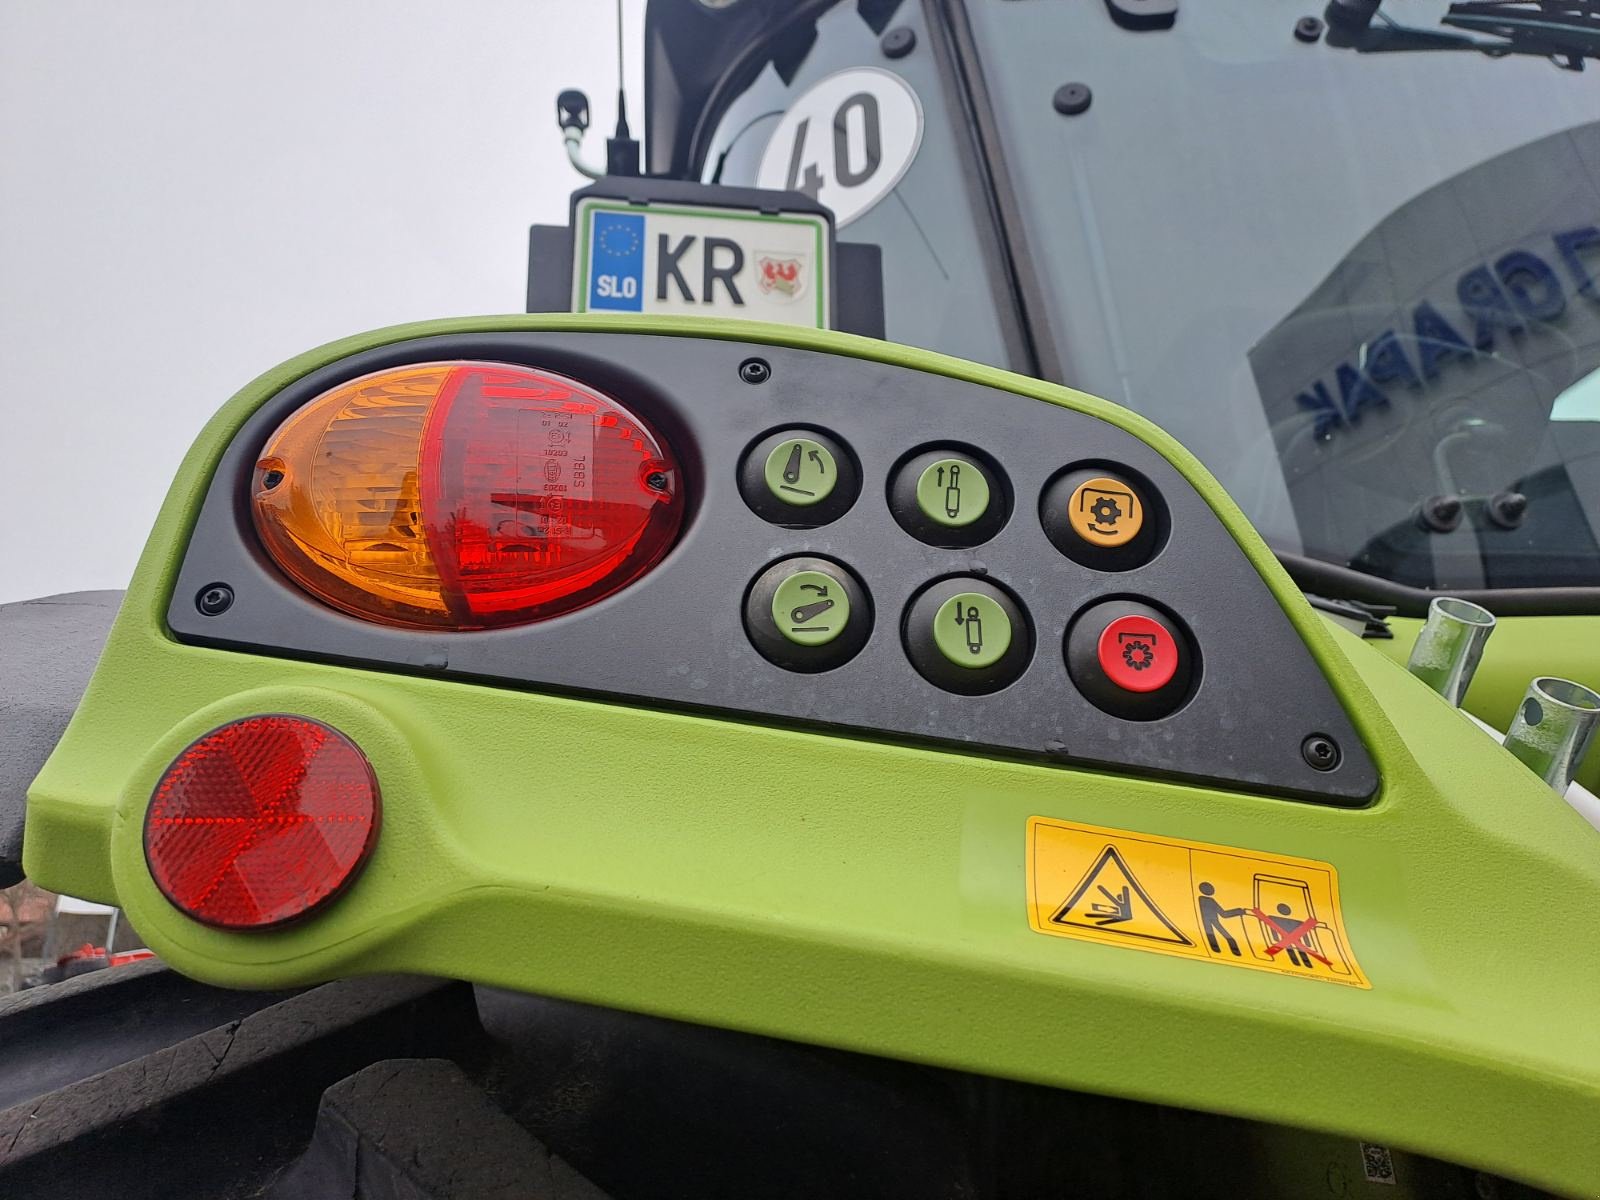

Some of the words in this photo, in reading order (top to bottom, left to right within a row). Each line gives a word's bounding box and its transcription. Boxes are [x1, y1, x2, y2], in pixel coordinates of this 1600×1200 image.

[787, 91, 882, 199] 40
[597, 275, 637, 299] SLO
[656, 233, 744, 306] KR
[573, 455, 586, 488] SBBL
